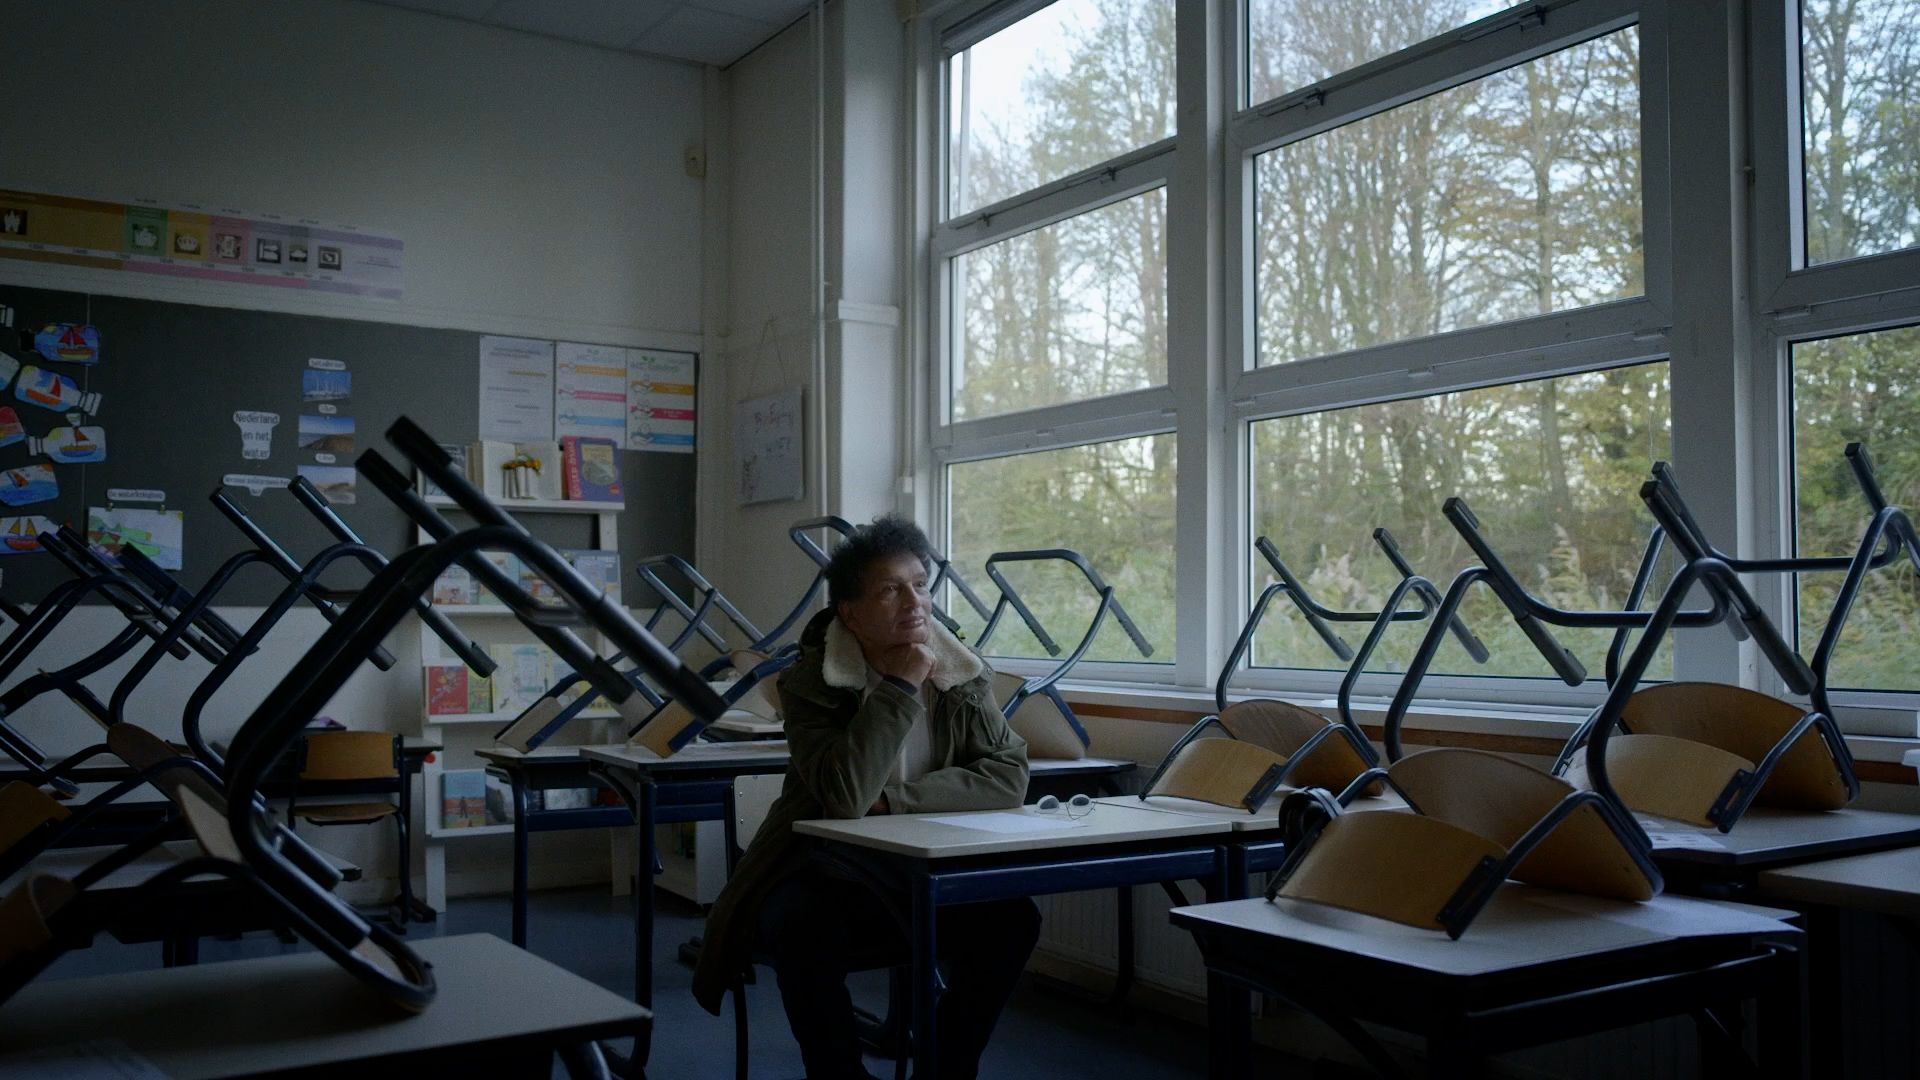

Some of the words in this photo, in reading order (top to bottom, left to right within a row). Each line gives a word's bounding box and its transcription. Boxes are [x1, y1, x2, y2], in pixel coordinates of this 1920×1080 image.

[236, 412, 278, 424] Nederland
[243, 432, 254, 440] en
[256, 431, 269, 441] het
[244, 448, 269, 458] water
